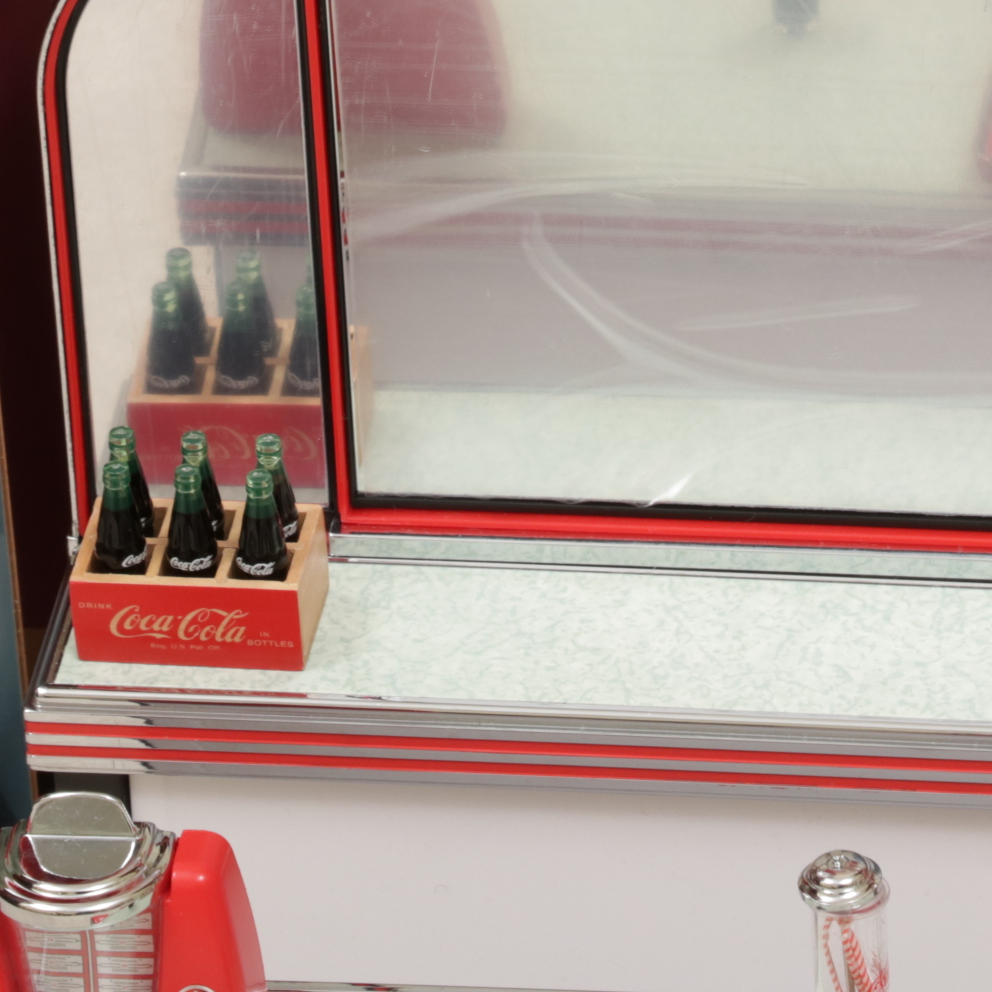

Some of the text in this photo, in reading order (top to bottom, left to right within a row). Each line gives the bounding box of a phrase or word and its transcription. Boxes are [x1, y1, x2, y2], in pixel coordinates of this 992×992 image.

[78, 602, 113, 610] DRINK
[109, 605, 249, 643] Coca-Cola
[246, 639, 294, 648] BOTTLES
